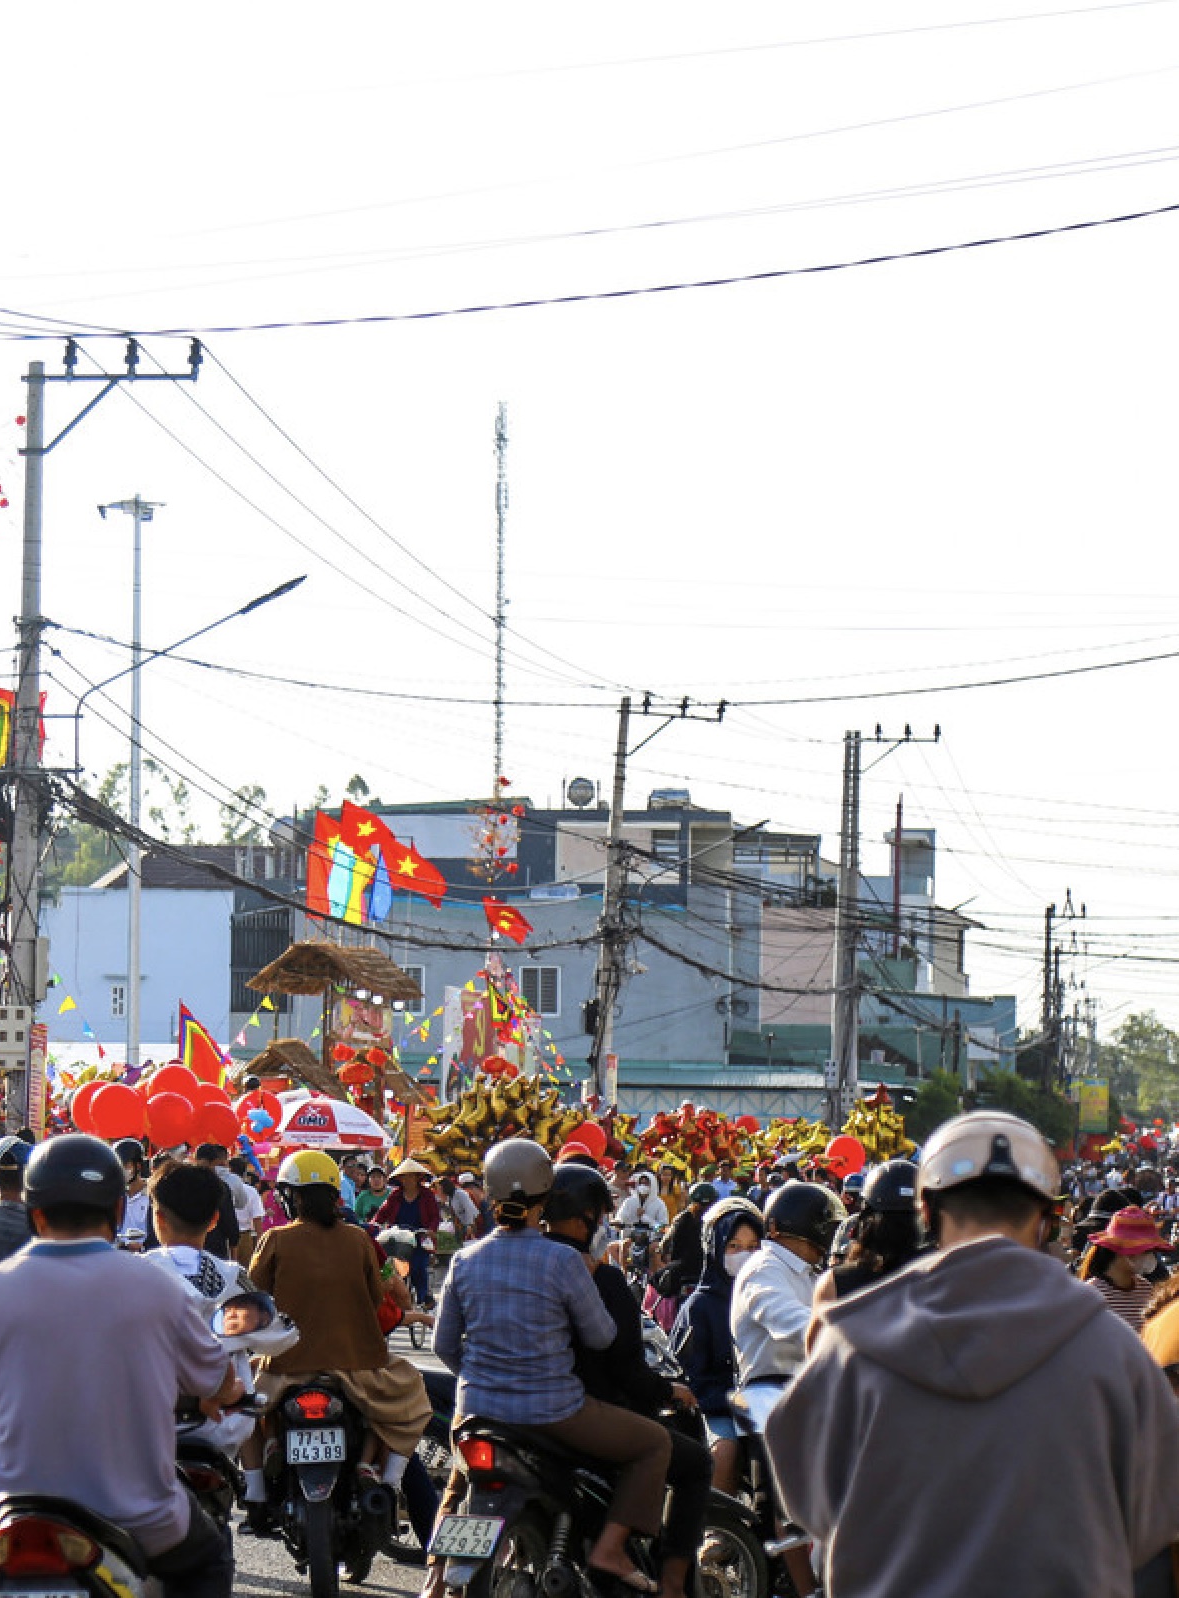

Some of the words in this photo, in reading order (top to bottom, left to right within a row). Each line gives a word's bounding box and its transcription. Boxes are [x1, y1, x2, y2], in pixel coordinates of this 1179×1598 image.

[296, 1431, 336, 1446] 77-L1
[292, 1445, 342, 1461] 943.89
[447, 1519, 492, 1537] 77-E1
